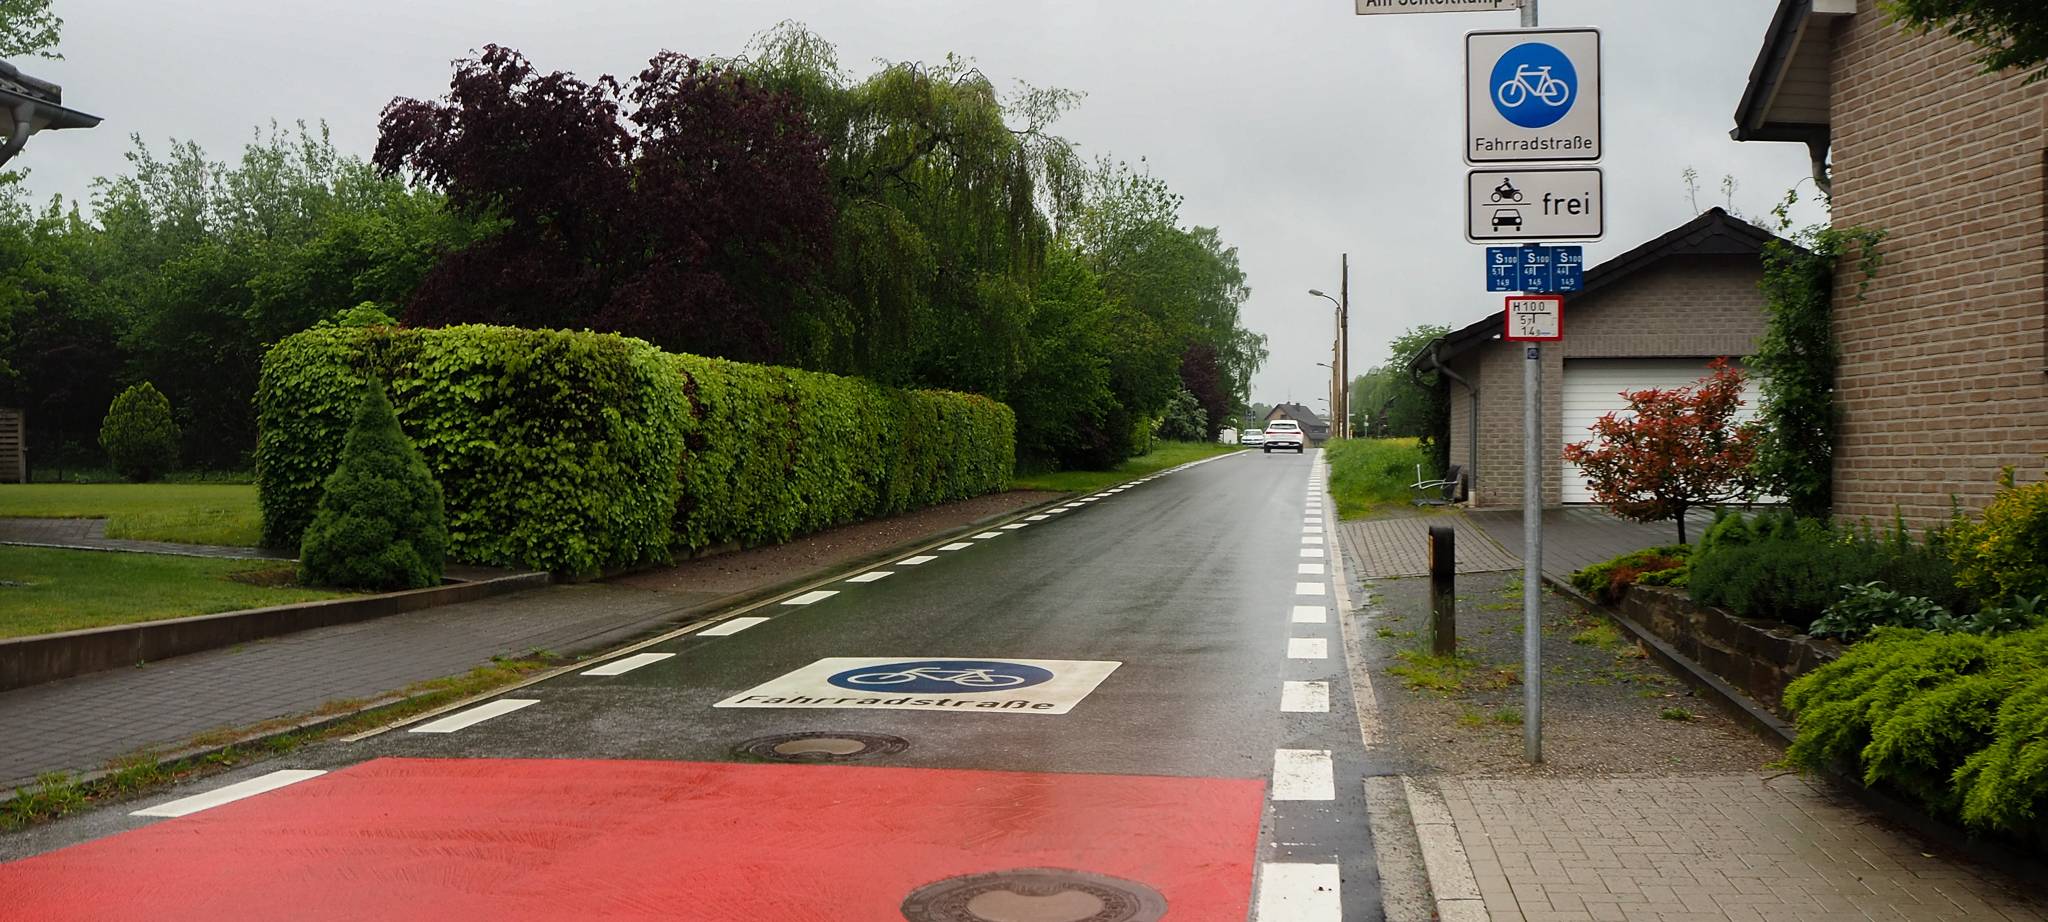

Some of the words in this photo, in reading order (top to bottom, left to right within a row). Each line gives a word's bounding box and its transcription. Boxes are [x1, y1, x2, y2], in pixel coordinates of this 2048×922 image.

[1476, 136, 1593, 151] Fahrradstraße
[1542, 192, 1590, 215] frei
[735, 695, 1055, 710] Fahrradstraße
